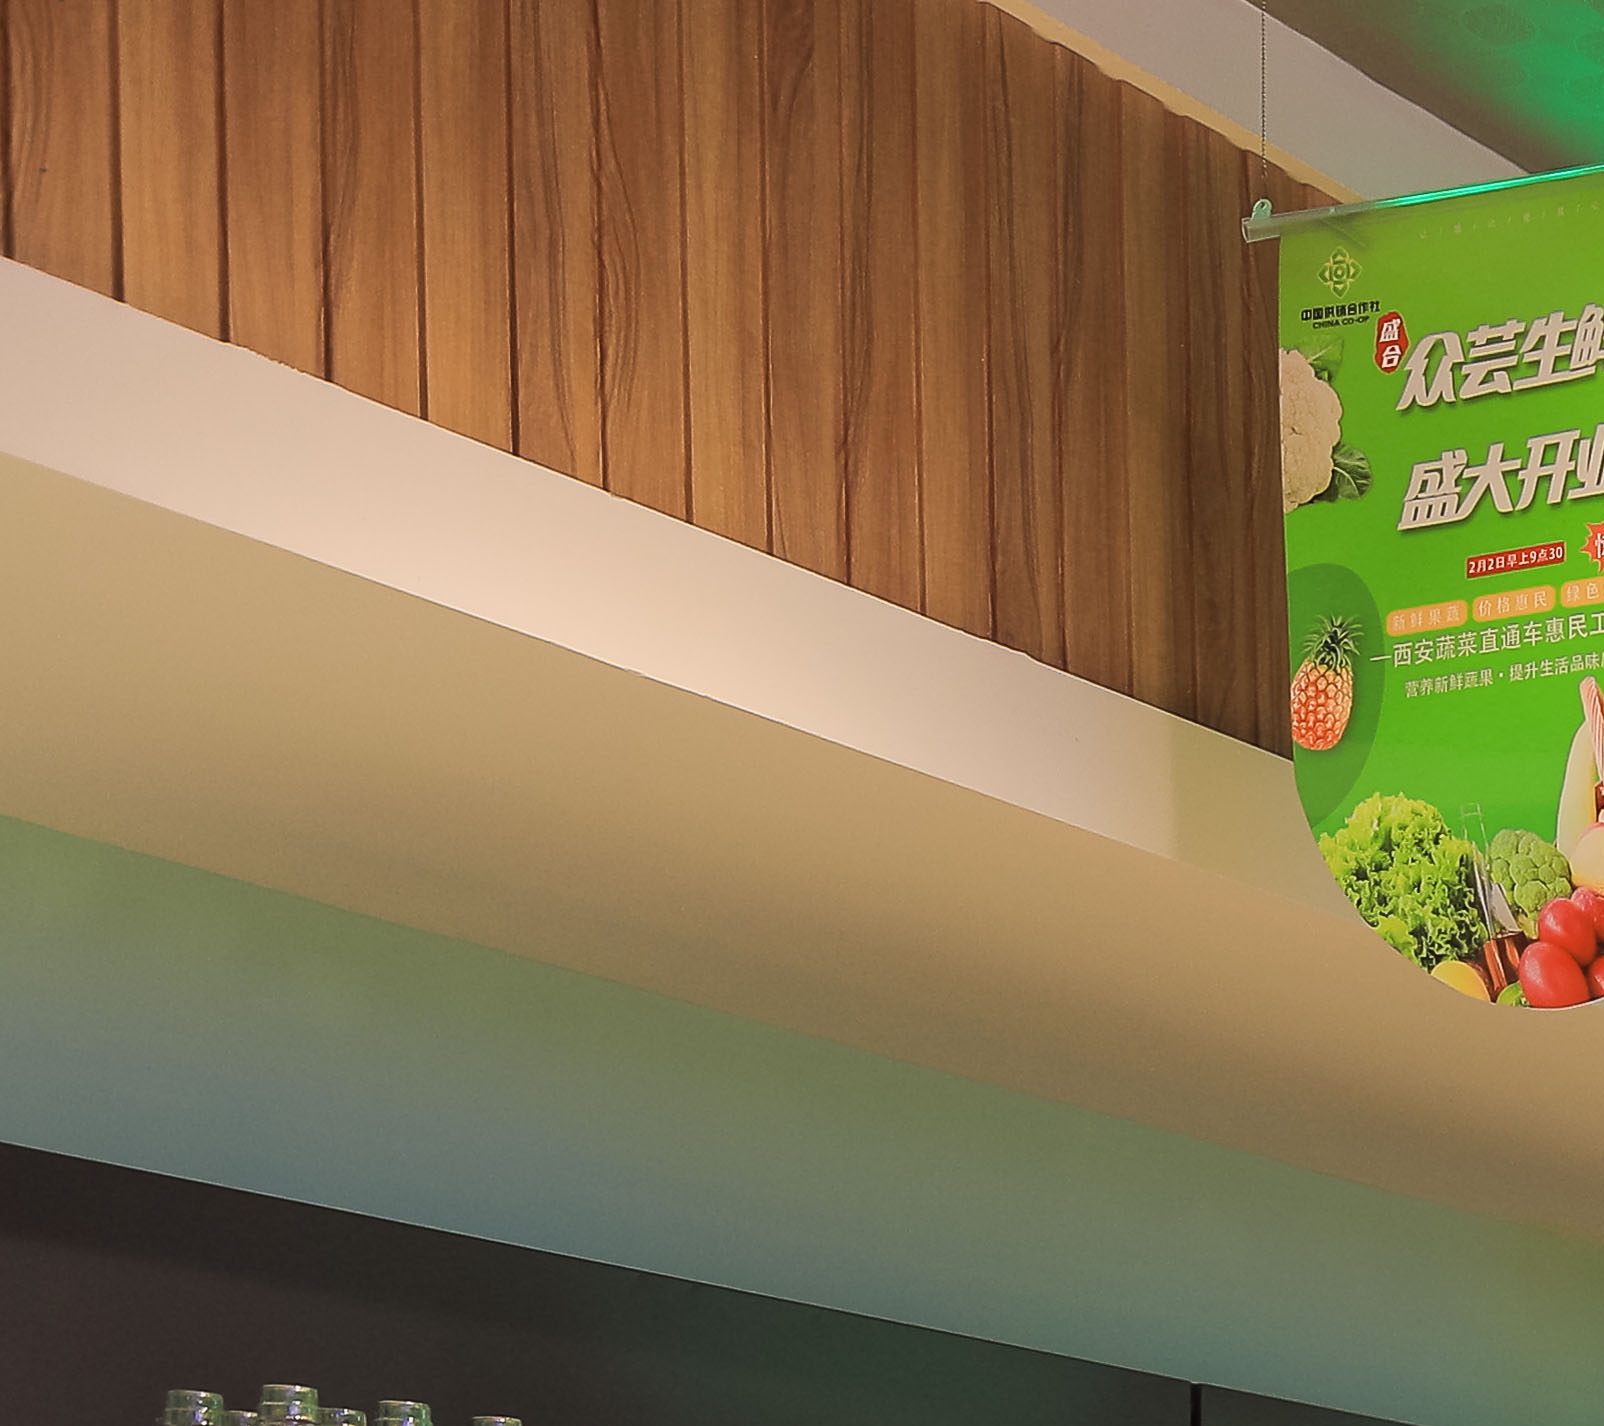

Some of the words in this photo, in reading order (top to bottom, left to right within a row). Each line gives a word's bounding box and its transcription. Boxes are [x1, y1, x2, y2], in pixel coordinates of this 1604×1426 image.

[1300, 301, 1380, 321] 中国供销合作社
[1313, 318, 1340, 329] CHINA
[1469, 546, 1563, 573] 2月2日早上9点30
[1392, 604, 1460, 630] 新鲜果蔬
[1478, 591, 1548, 617] 价格惠民
